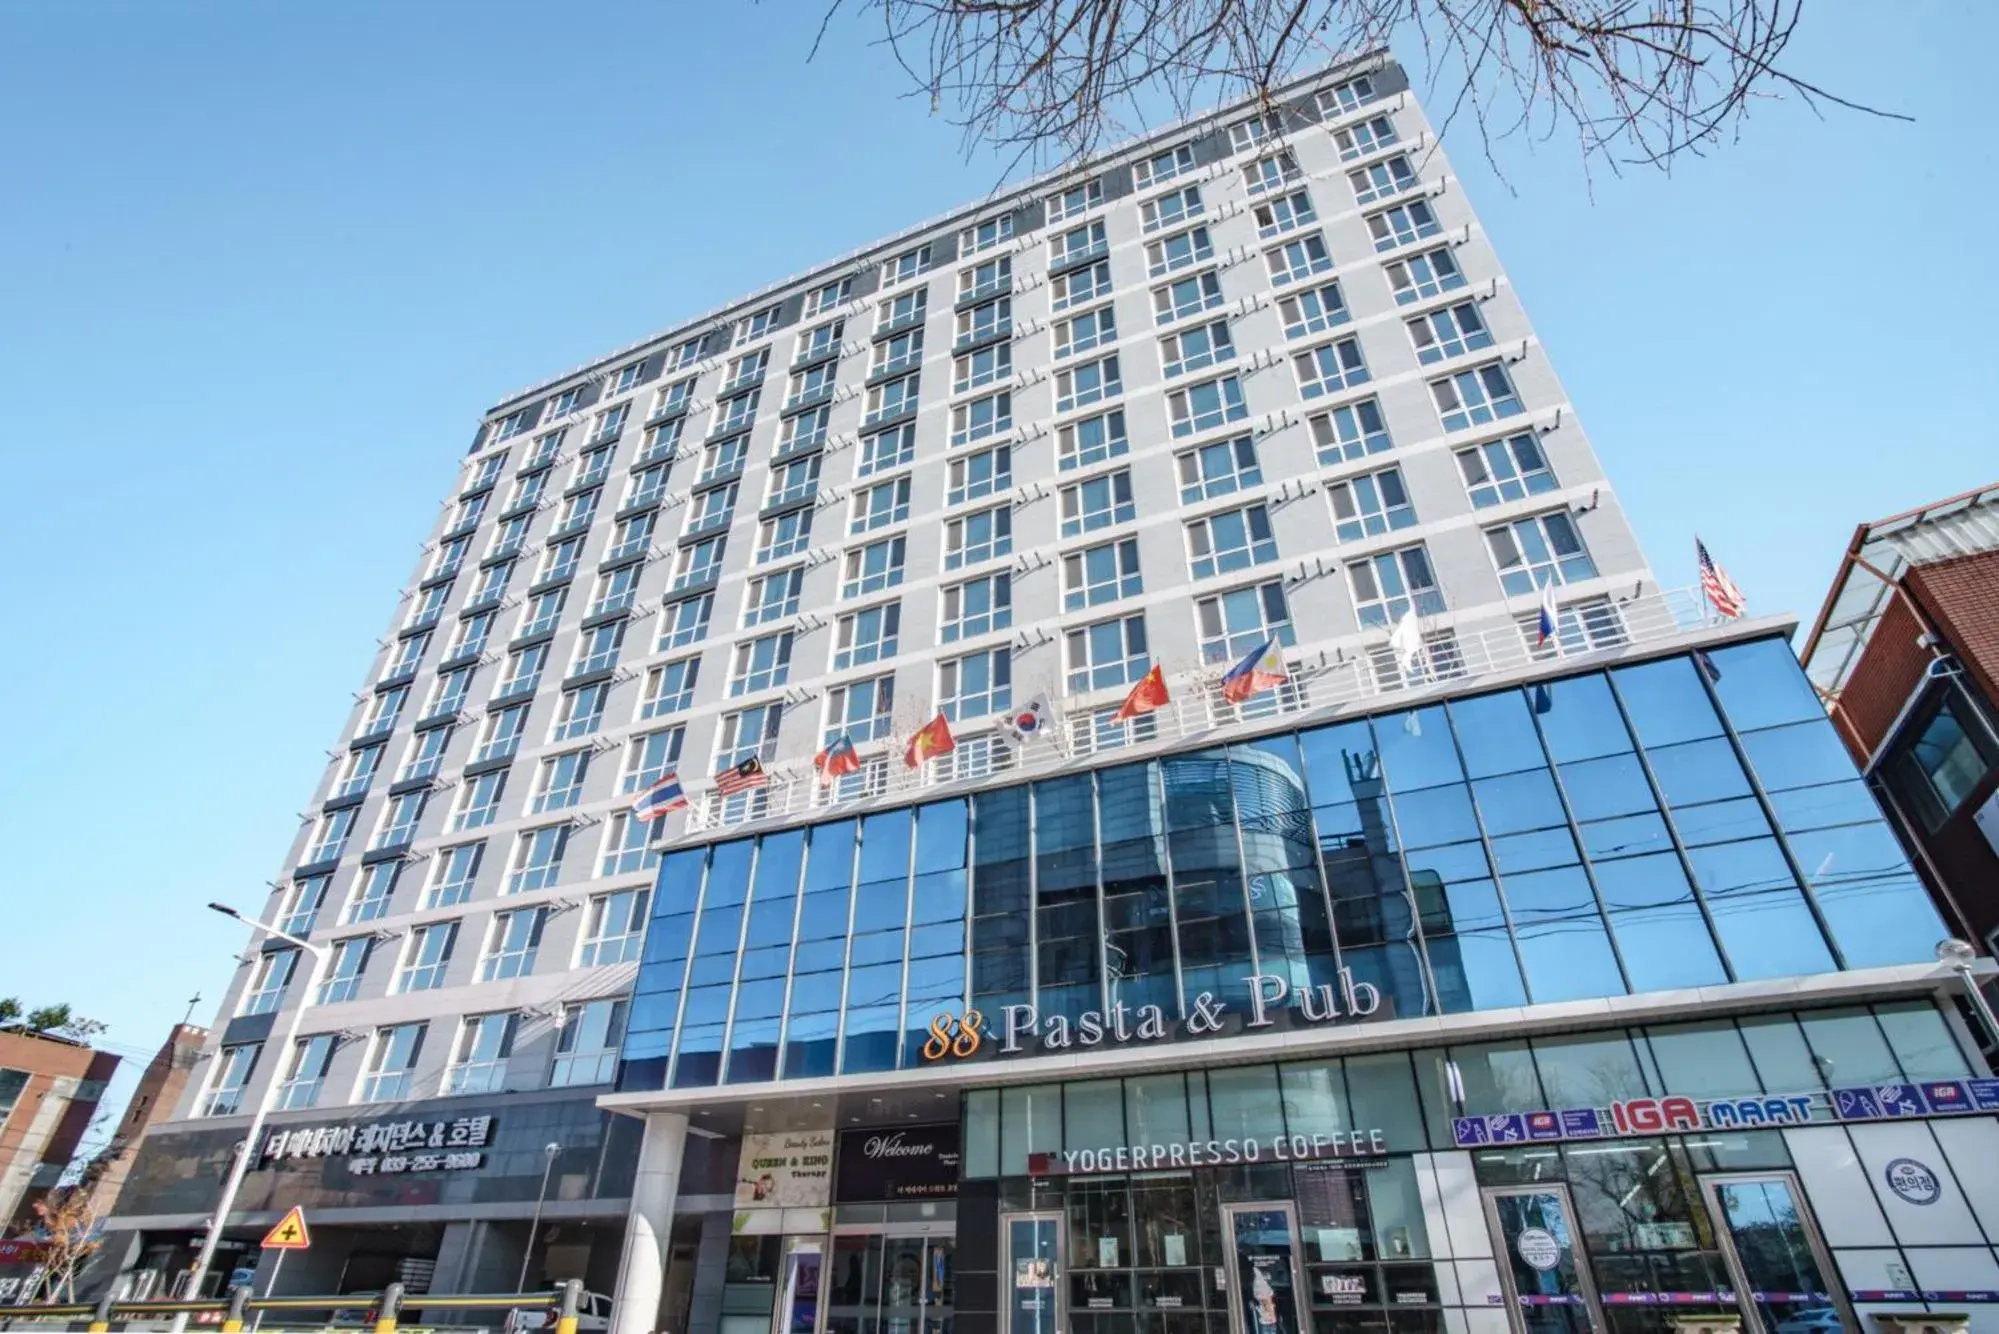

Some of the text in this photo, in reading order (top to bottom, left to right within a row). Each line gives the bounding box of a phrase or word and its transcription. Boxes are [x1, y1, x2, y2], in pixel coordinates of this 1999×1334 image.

[923, 966, 1382, 1061] 88 Pasta & Pub
[1611, 1095, 1701, 1133] IGA
[1709, 1096, 1813, 1127] MART
[354, 1119, 427, 1152] 레지던스
[428, 1121, 446, 1147] &
[447, 1115, 493, 1147] 호텔
[863, 1132, 934, 1159] Welcome
[1063, 1128, 1387, 1174] YOGERPRESSO COFFEE
[1894, 1175, 1933, 1192] 편의점
